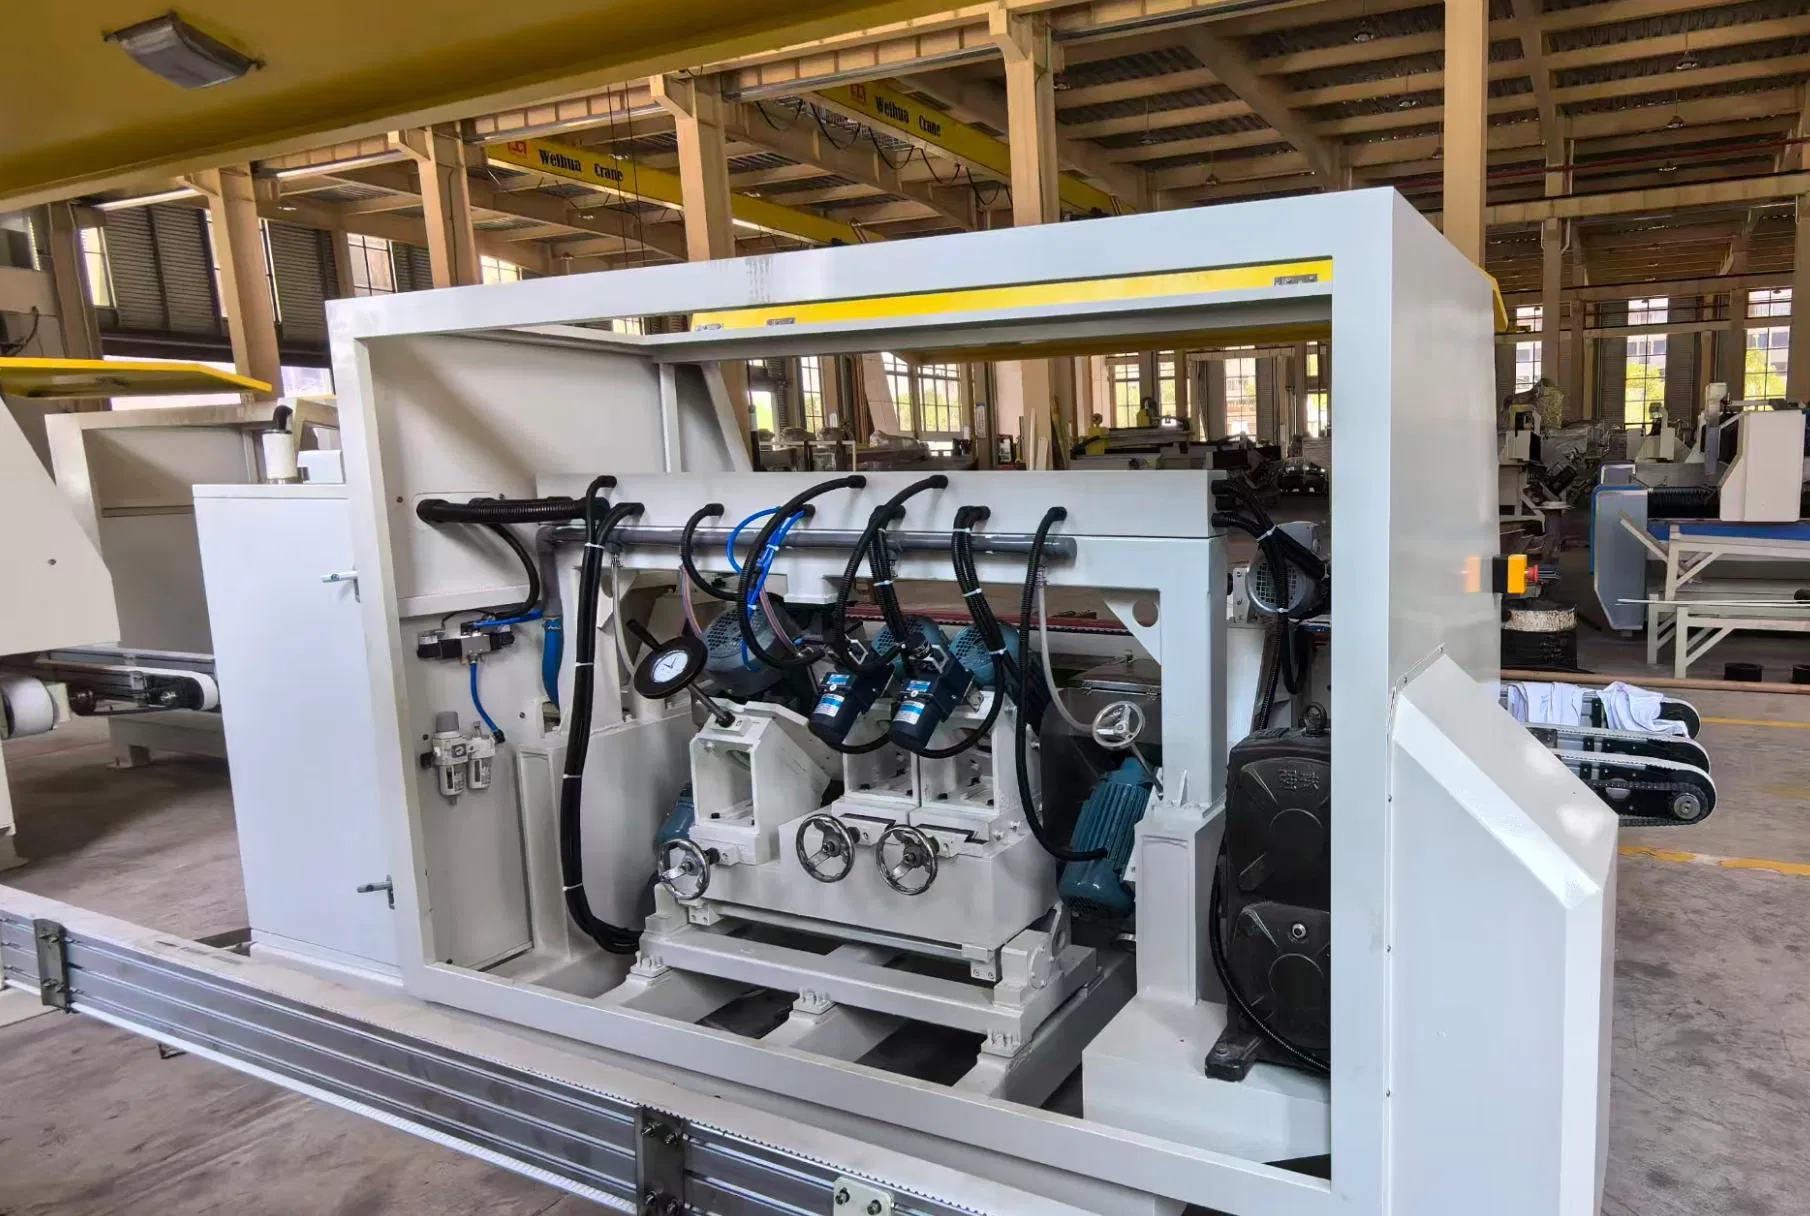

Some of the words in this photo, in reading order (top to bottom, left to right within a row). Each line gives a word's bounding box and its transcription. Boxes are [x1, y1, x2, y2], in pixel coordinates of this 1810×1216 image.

[876, 95, 909, 124] Weihua
[918, 115, 942, 137] Crane
[539, 149, 582, 172] Weihua
[594, 163, 624, 181] Crane
